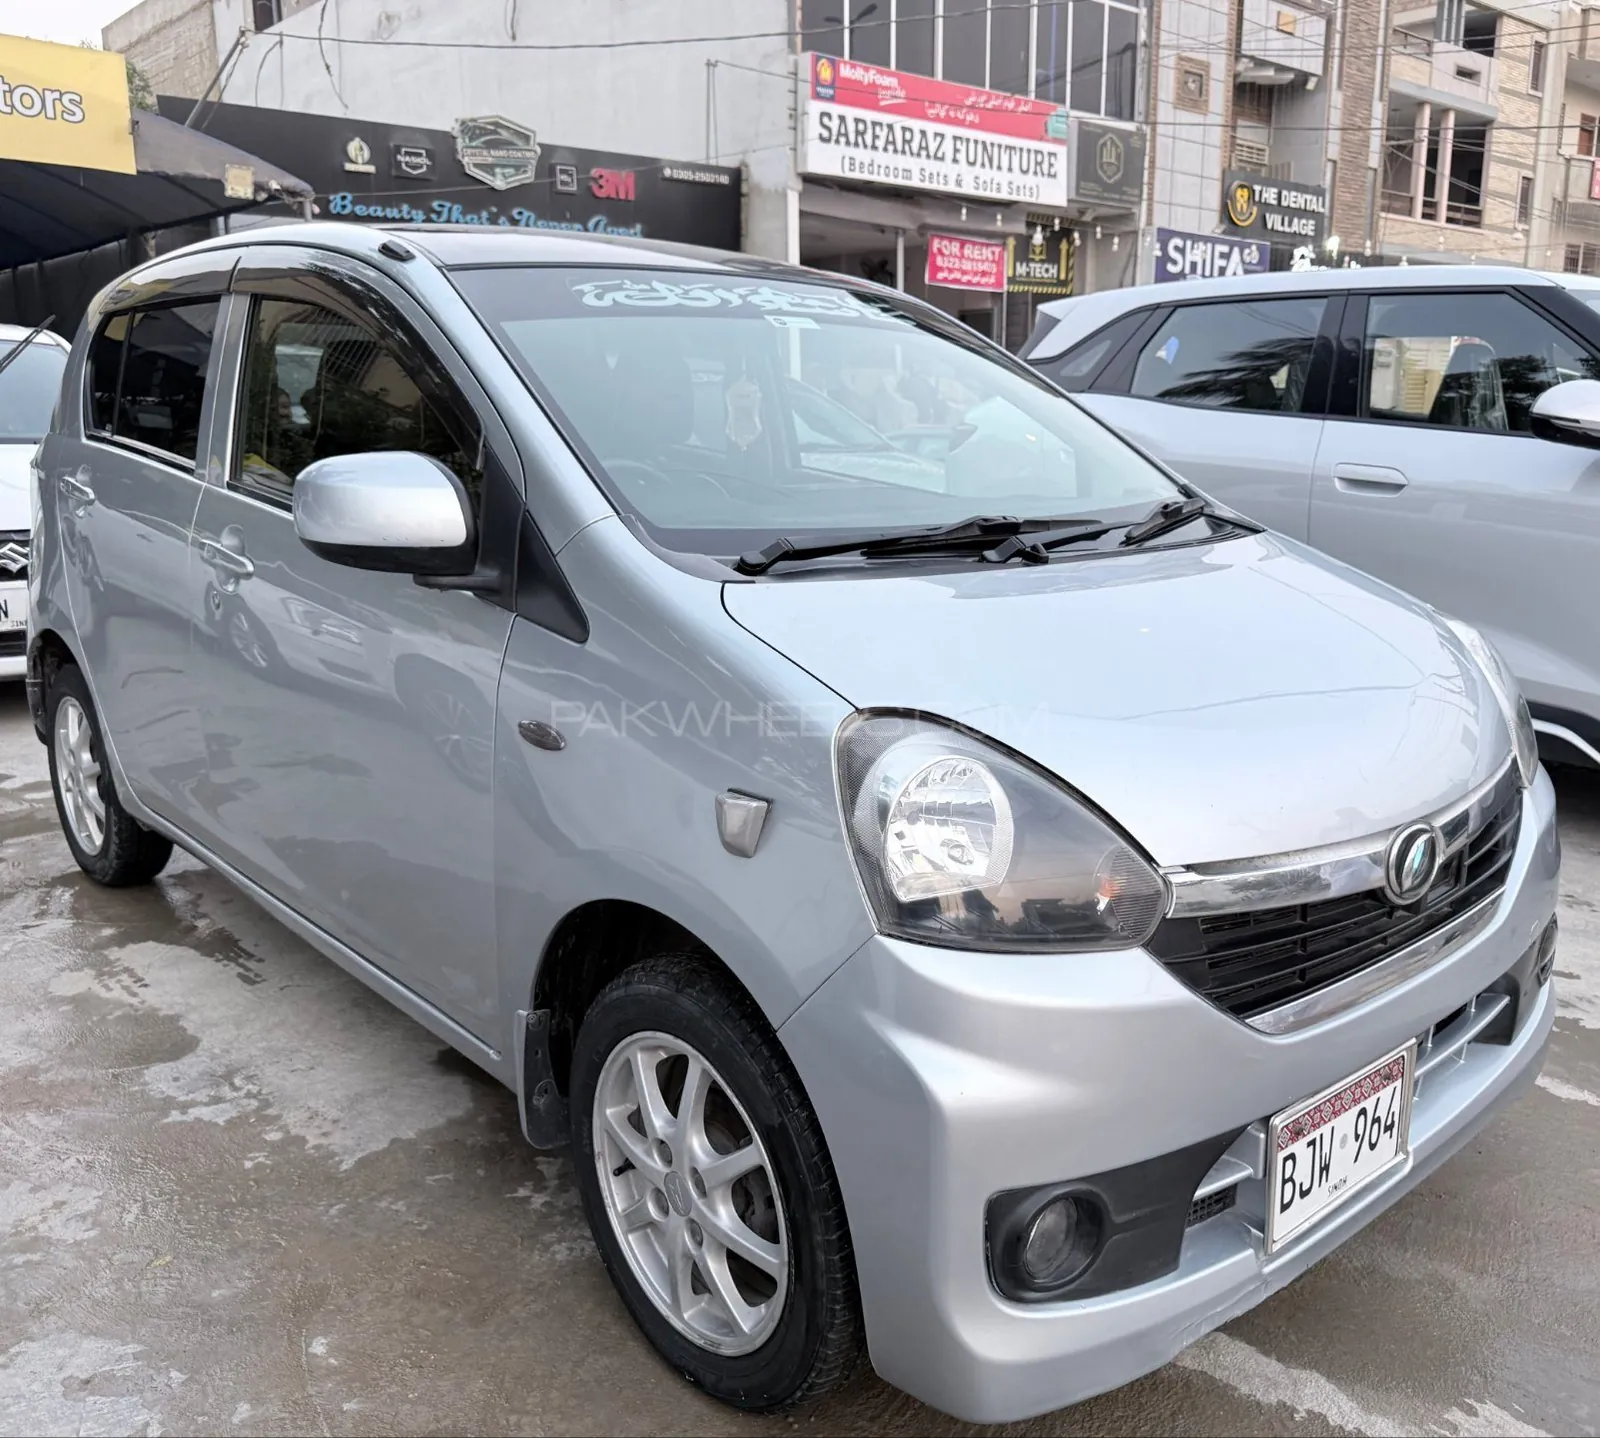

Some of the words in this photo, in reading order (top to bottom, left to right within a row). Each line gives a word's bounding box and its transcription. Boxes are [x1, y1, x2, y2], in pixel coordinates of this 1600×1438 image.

[839, 62, 899, 87] MoltyFoam
[0, 75, 85, 123] tors
[818, 111, 946, 163] SARFARAZ
[952, 135, 1058, 180] FUNITURE
[590, 167, 636, 201] 3M
[840, 154, 913, 182] (Bedroom
[919, 166, 949, 188] Sets
[955, 173, 963, 188] &
[973, 175, 1003, 195] Sofa
[1007, 180, 1041, 201] Sets)
[328, 192, 427, 224] Beauty
[1252, 184, 1279, 205] THE
[1281, 190, 1326, 213] DENTAL
[1264, 212, 1316, 237] VILLAGE
[932, 238, 961, 257] FOR
[963, 243, 1003, 261] RENT
[1165, 237, 1245, 277] SHIFA
[1015, 260, 1058, 279] M-TECH
[10, 619, 27, 628] SIN
[1280, 1126, 1334, 1215] BJW
[1353, 1086, 1397, 1164] 964
[1327, 1175, 1348, 1198] SINDH
